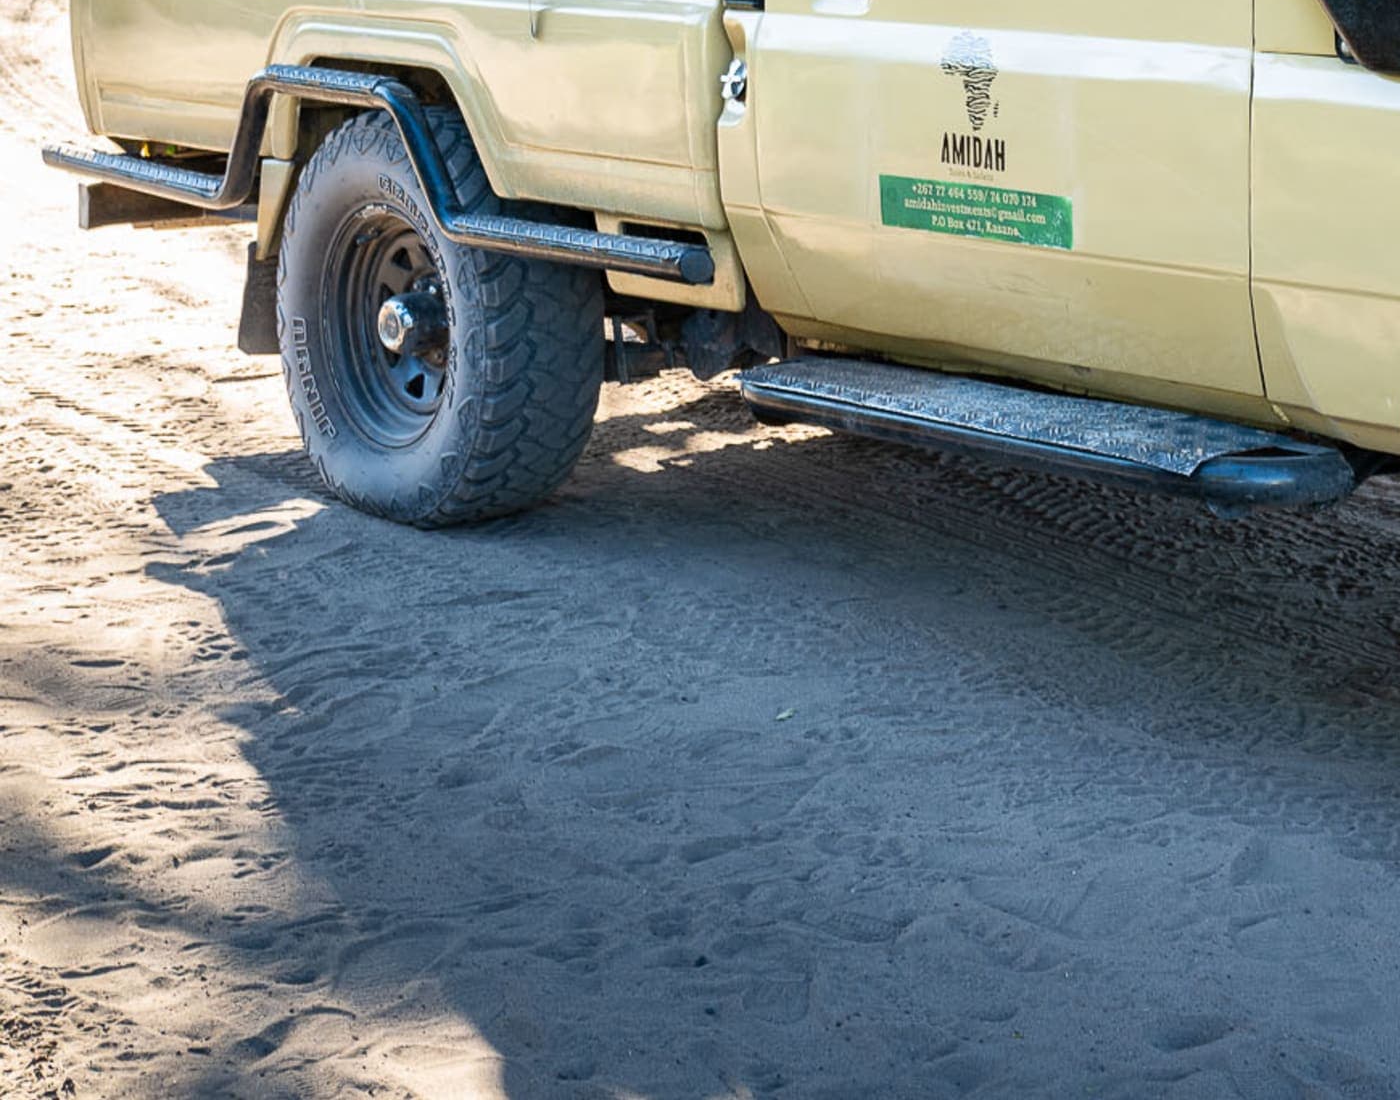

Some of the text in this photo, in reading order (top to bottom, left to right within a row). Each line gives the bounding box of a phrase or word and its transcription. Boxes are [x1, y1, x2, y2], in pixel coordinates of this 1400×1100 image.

[941, 132, 1005, 172] AMIDAH
[936, 185, 945, 197] 77
[948, 216, 965, 229] Box
